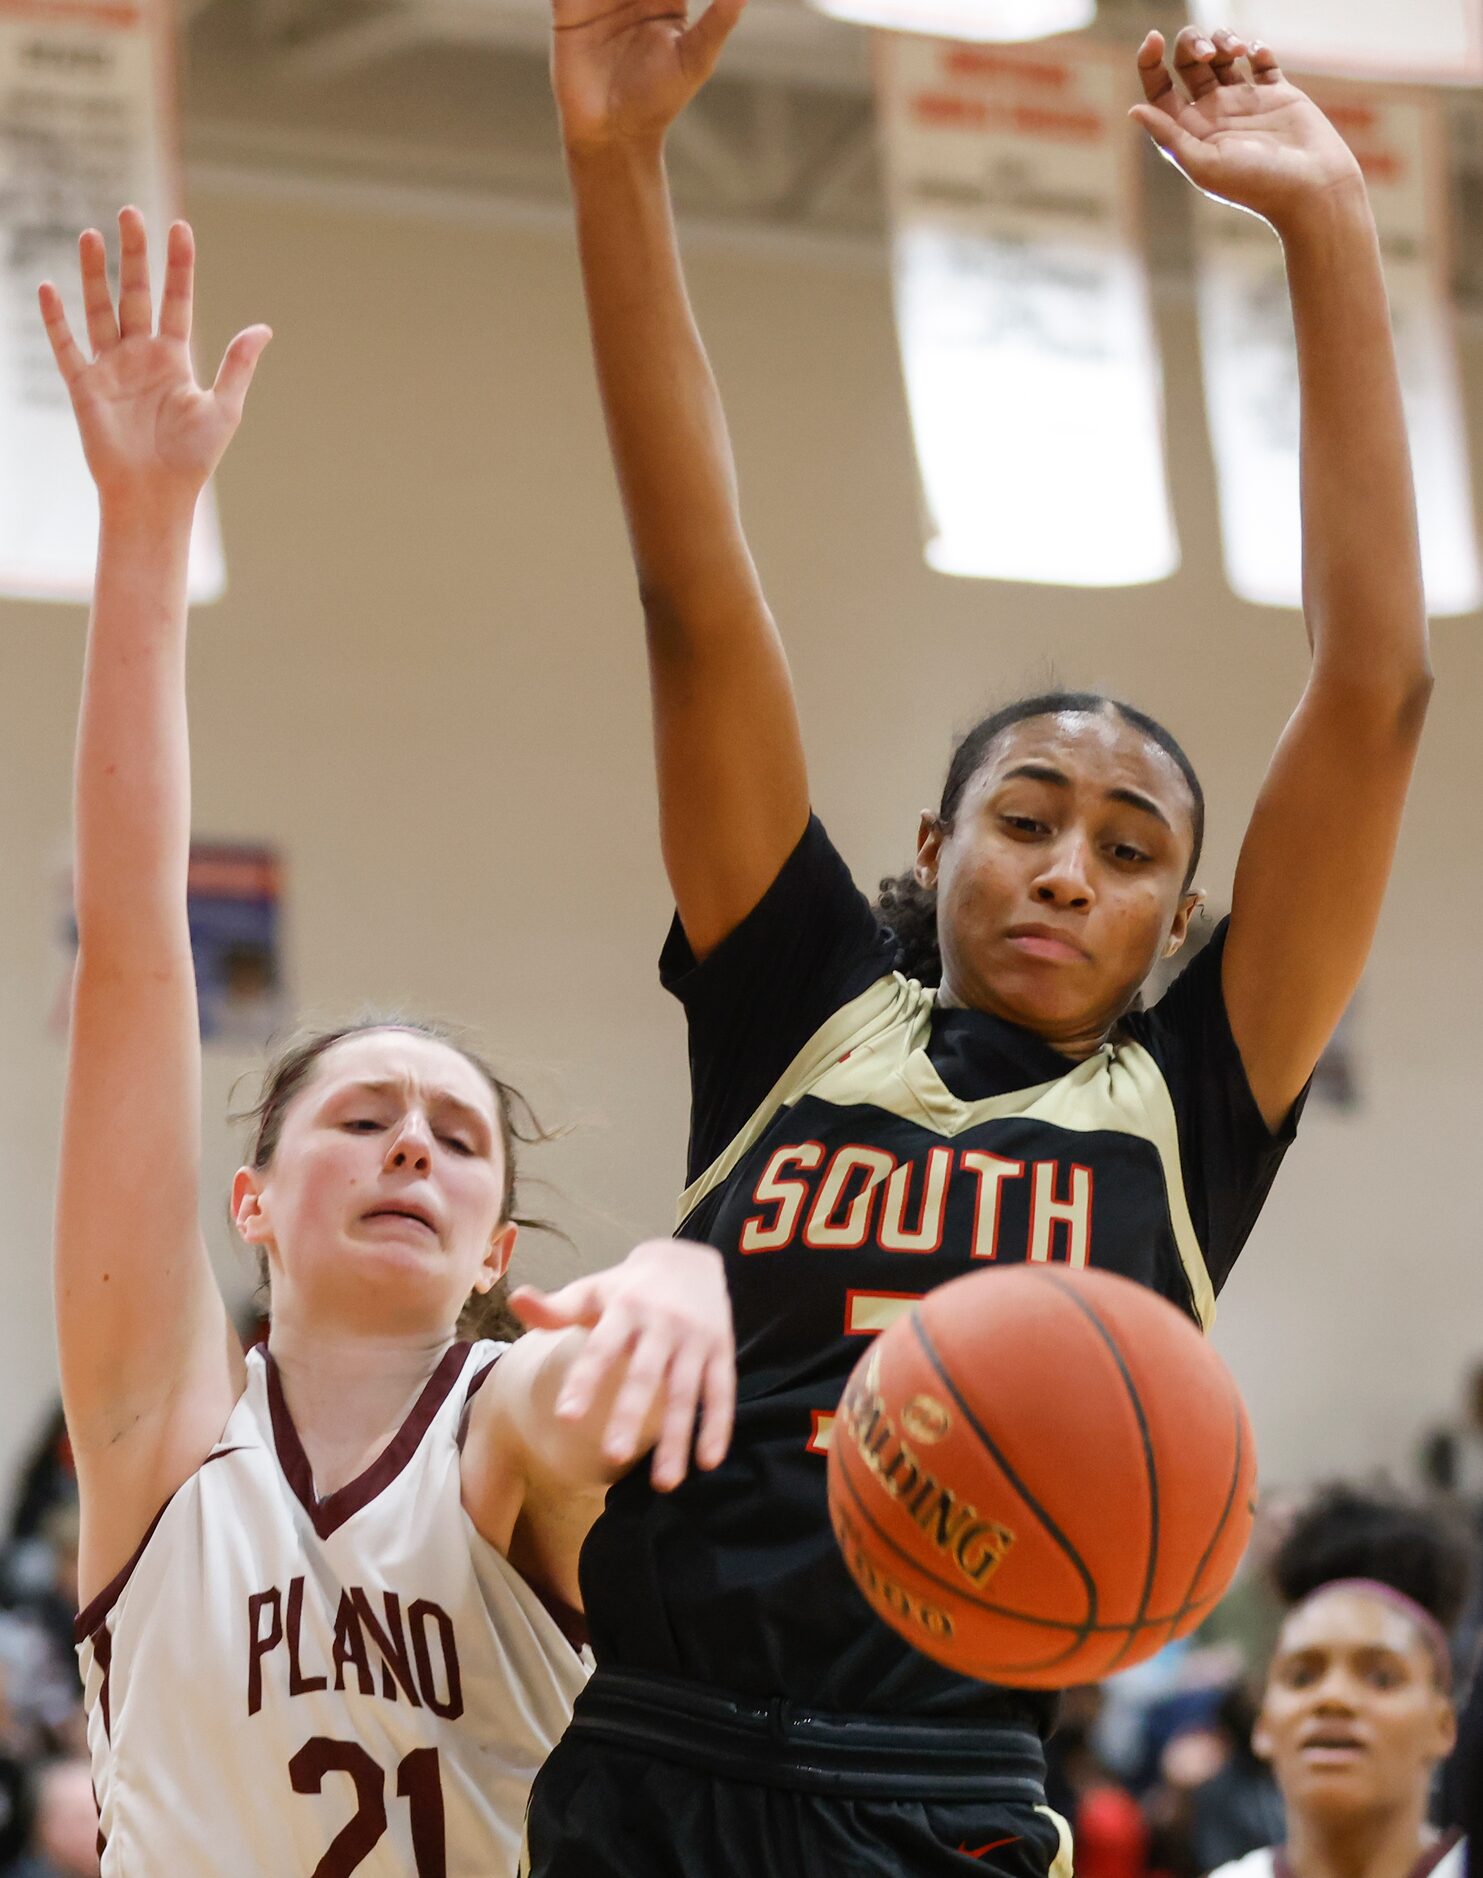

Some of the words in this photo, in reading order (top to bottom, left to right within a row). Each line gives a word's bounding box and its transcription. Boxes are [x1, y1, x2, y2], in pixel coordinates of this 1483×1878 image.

[739, 1139, 1093, 1269] SOUTH
[843, 1342, 1016, 1590] ALDING
[247, 1576, 464, 1721] PLANO
[288, 1737, 447, 1878] 21
